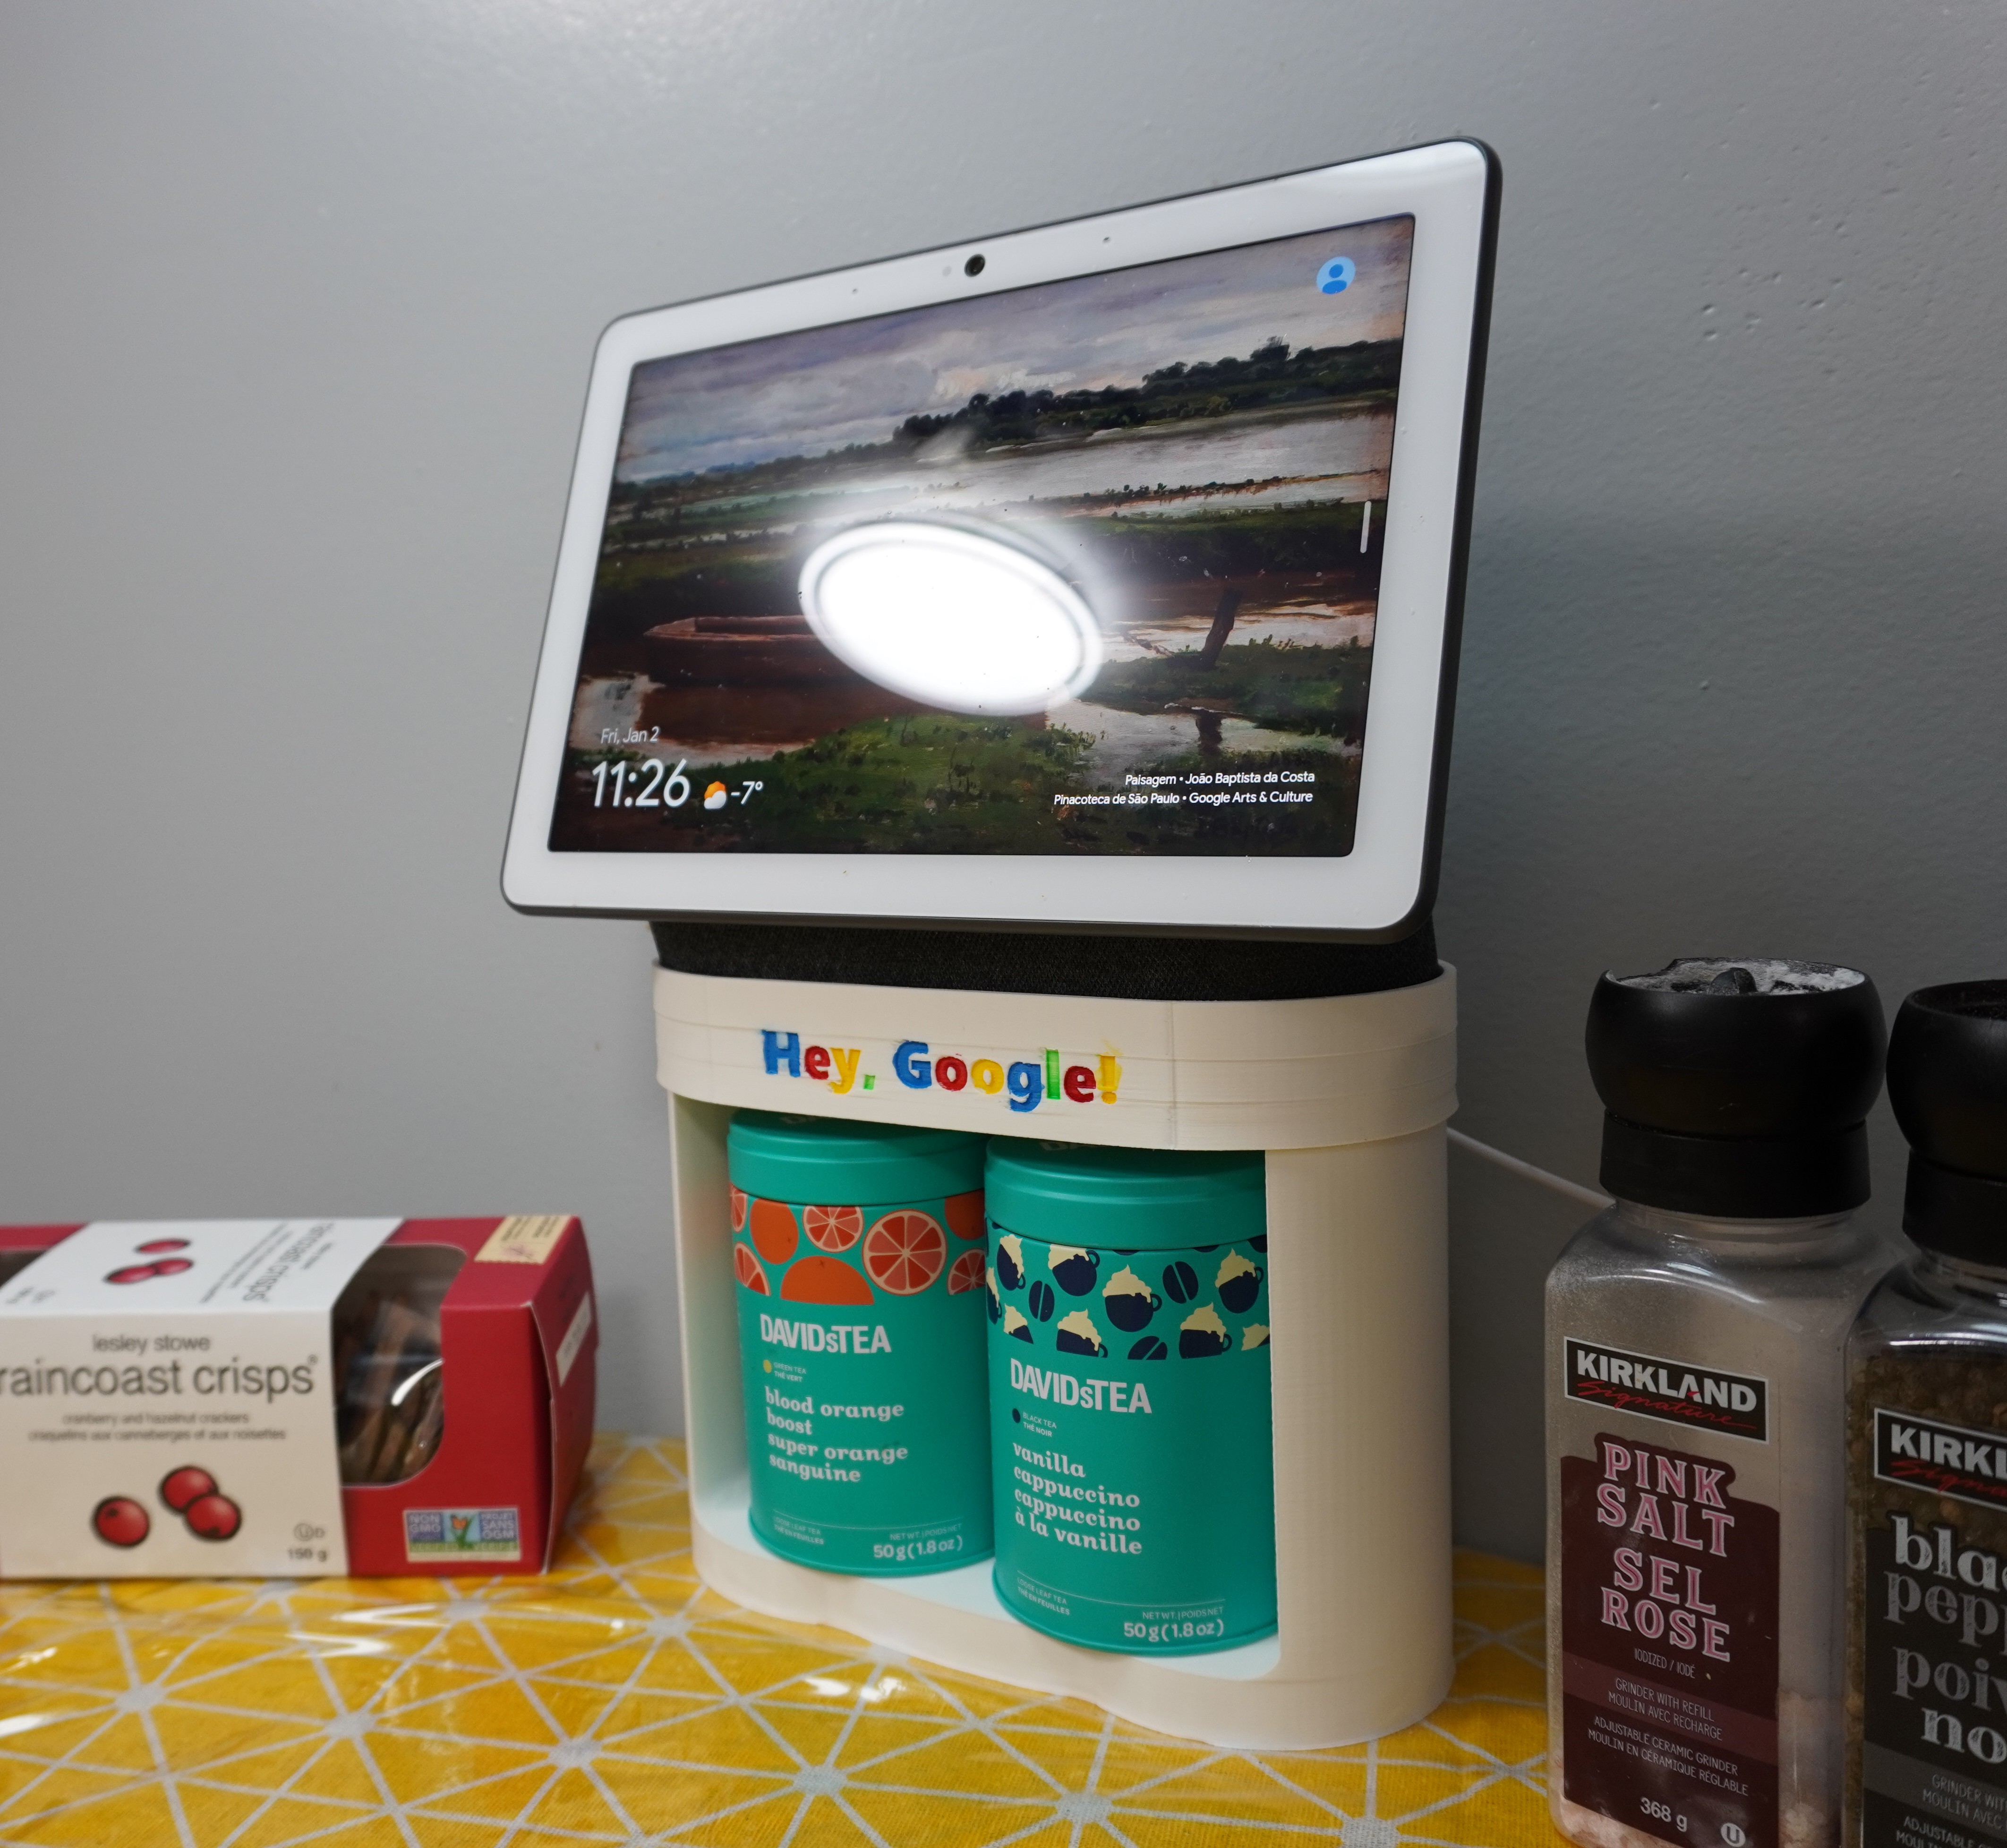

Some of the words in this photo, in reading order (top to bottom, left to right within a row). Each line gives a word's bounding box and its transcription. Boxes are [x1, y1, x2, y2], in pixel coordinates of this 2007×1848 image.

[600, 727, 620, 744] Fri,
[622, 727, 647, 743] Jan
[650, 726, 659, 742] 2
[592, 758, 691, 808] 11:26
[1054, 794, 1110, 804] Pinacoteca
[1112, 793, 1126, 804] de
[1127, 793, 1148, 804] São
[1151, 793, 1180, 804] Paulo
[1189, 792, 1230, 806] Google
[1232, 792, 1257, 803] Arts
[1259, 791, 1268, 803] &
[1270, 791, 1313, 802] Culture
[1125, 774, 1177, 787] Paisagem
[1185, 773, 1213, 784] João
[1215, 772, 1261, 787] Baptista
[1263, 771, 1278, 783] da
[1280, 771, 1315, 783] Costa
[761, 1029, 877, 1094] Hey,
[892, 1039, 1119, 1112] Google!
[92, 1335, 147, 1355] lesley
[154, 1335, 212, 1352] stowe
[0, 1357, 183, 1396] raincoast
[786, 1374, 803, 1382] VERT
[794, 1367, 807, 1375] TEA
[1577, 1349, 1757, 1412] KIRKLAND
[765, 1386, 814, 1414] blood
[820, 1403, 905, 1422] orange
[766, 1406, 812, 1435] boost
[1023, 1412, 1042, 1425] BLACK
[1043, 1419, 1057, 1429] TEA
[1577, 1380, 1757, 1429] Signature
[1023, 1421, 1034, 1432] THÉ
[1035, 1427, 1052, 1437] NOIR
[768, 1433, 819, 1456] super
[824, 1446, 909, 1465] orange
[769, 1454, 861, 1482] sanguine
[1012, 1442, 1086, 1478] vanilla
[1014, 1466, 1140, 1507] cappuccino
[1603, 1441, 1726, 1509] PINK
[1015, 1489, 1141, 1531] cappuccino
[1597, 1482, 1735, 1557] SALT
[890, 1533, 906, 1541] NET
[947, 1523, 962, 1532] NET
[1015, 1506, 1025, 1526] à
[1029, 1512, 1049, 1537] la
[1054, 1527, 1142, 1555] vanille
[1891, 1514, 2007, 1592] bla
[1053, 1595, 1067, 1605] TEA
[1614, 1547, 1717, 1616] SEL
[1037, 1597, 1070, 1616] FEUILLES
[1142, 1612, 1160, 1620] NET
[1181, 1609, 1208, 1619] POIDS
[1208, 1607, 1223, 1616] NET
[1600, 1586, 1730, 1662] ROSE
[1883, 1570, 2007, 1656] pep
[1634, 1647, 1667, 1669] IODIZED
[1677, 1661, 1696, 1679] IODÉ
[1607, 1690, 1645, 1715] MOULIN
[1648, 1705, 1671, 1723] AVEC
[1674, 1713, 1723, 1742] RECHARGE
[1615, 1677, 1655, 1702] GRINDER
[1657, 1691, 1680, 1711] WITH
[1682, 1700, 1715, 1722] REFILL
[1588, 1728, 1624, 1751] MOULIN
[1627, 1743, 1639, 1757] EN
[1641, 1748, 1697, 1779] CÉRAMIQUE
[1699, 1768, 1749, 1797] RÉGLABLE
[1594, 1715, 1650, 1746] ADJUSTABLE
[1651, 1736, 1694, 1761] CERAMIC
[1696, 1752, 1738, 1776] GRINDER
[1922, 1788, 1970, 1818] MOULIN
[1973, 1807, 2002, 1830] AVEC
[1932, 1774, 1982, 1804] GRINDER
[1984, 1793, 2007, 1813] WIT
[1640, 1797, 1672, 1822] 368
[1676, 1814, 1687, 1832] g
